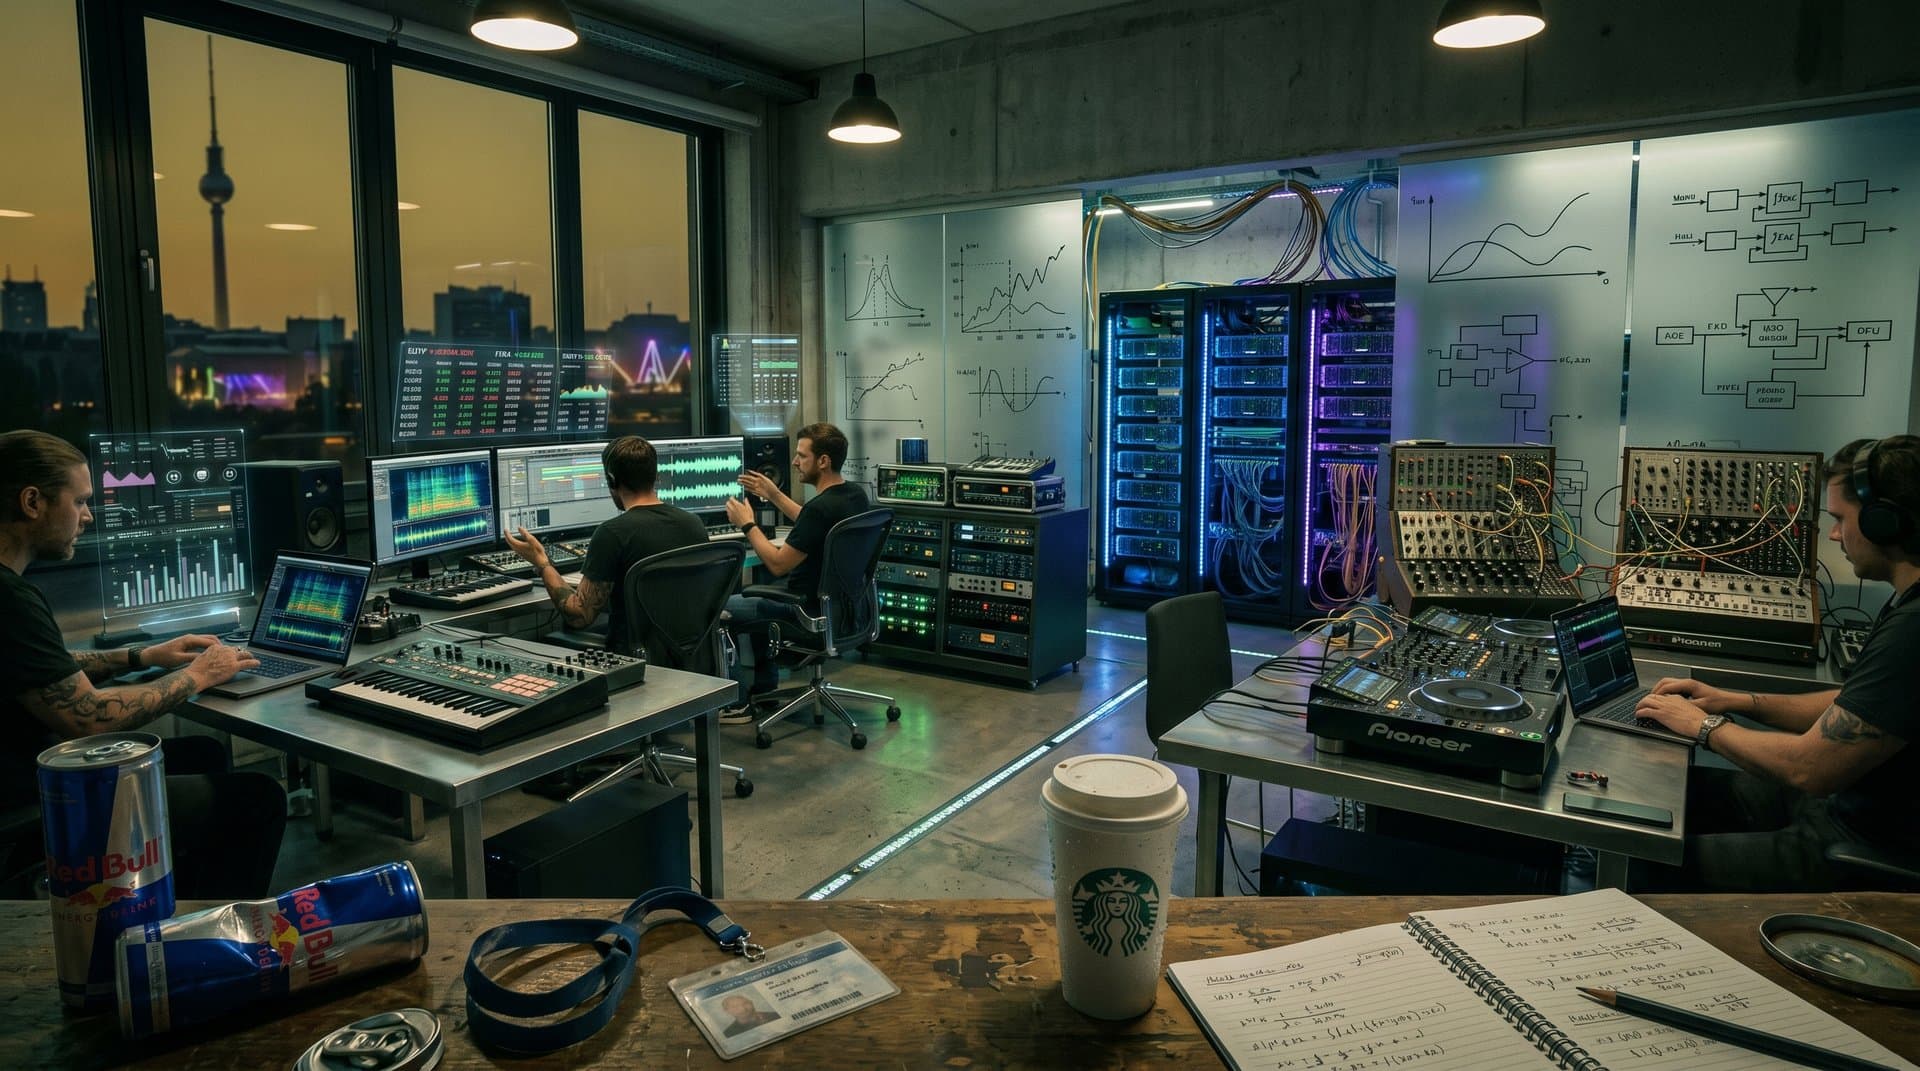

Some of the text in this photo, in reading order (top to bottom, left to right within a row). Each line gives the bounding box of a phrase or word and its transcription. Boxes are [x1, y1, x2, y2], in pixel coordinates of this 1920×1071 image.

[1367, 722, 1473, 753] Pioneer
[47, 837, 160, 883] Red Bull
[291, 887, 340, 983] Red Bull
